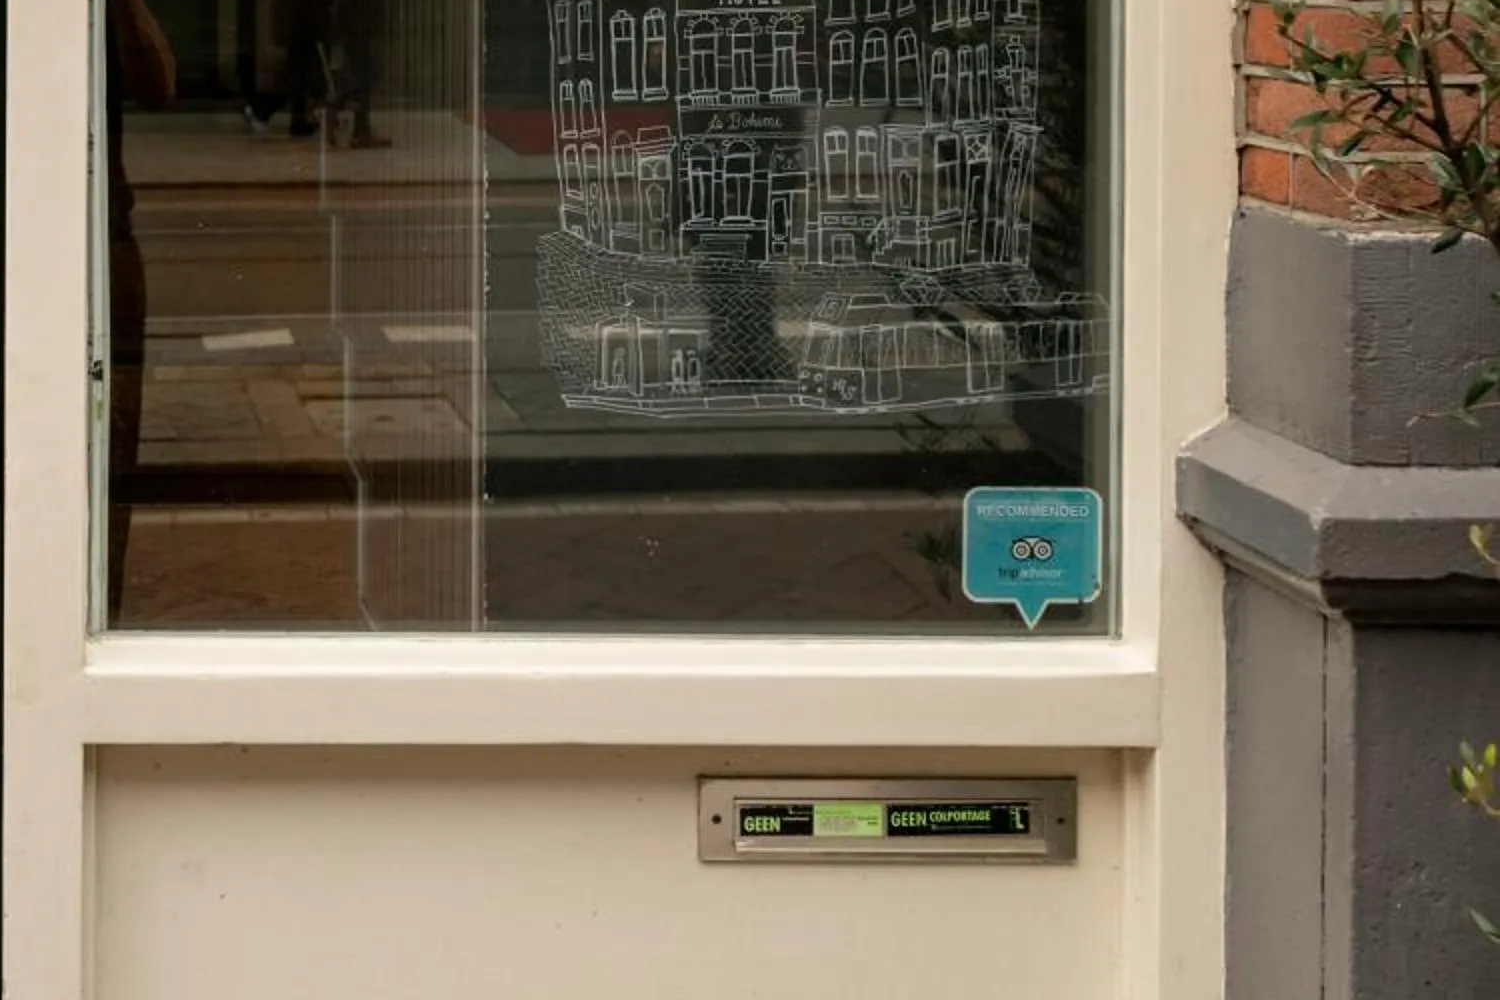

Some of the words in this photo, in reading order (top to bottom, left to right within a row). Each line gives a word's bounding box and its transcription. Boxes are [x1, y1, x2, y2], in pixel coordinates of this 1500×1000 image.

[976, 504, 1091, 518] RECOMMENDED
[743, 816, 781, 833] GEEN
[890, 811, 928, 828] GEEN
[929, 810, 992, 823] COLPORTAGE
